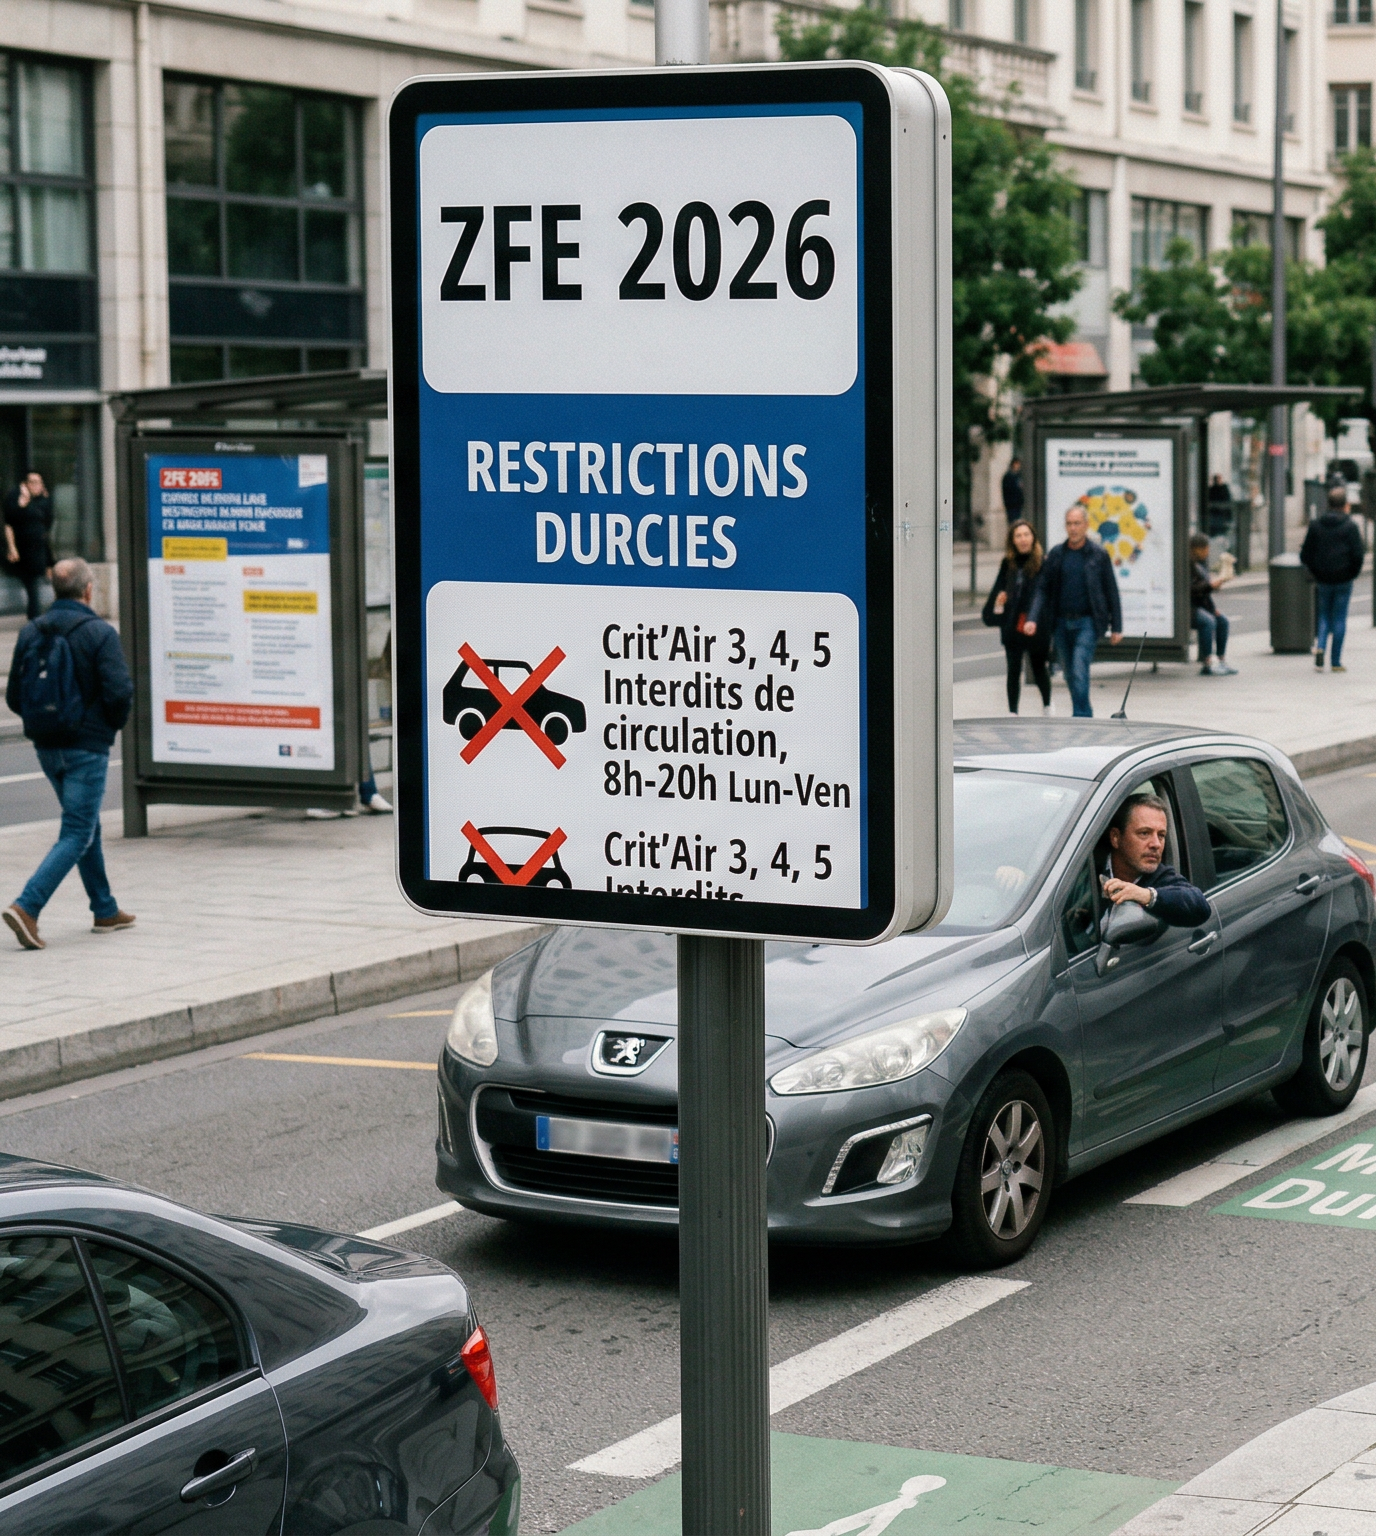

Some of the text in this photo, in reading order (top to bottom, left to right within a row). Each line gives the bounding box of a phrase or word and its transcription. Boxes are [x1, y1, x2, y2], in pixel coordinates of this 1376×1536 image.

[440, 199, 836, 302] ZFE 2026
[467, 440, 808, 499] RESTRICTIONS
[536, 511, 737, 569] DURCIES
[603, 623, 831, 672] Crit'Air 3, 4, 5
[604, 669, 795, 713] Interdits de
[603, 713, 788, 765] circulation,
[603, 759, 851, 809] 8h-20h Lun-Ven
[604, 830, 832, 884] Crit'Air 3, 4, 5
